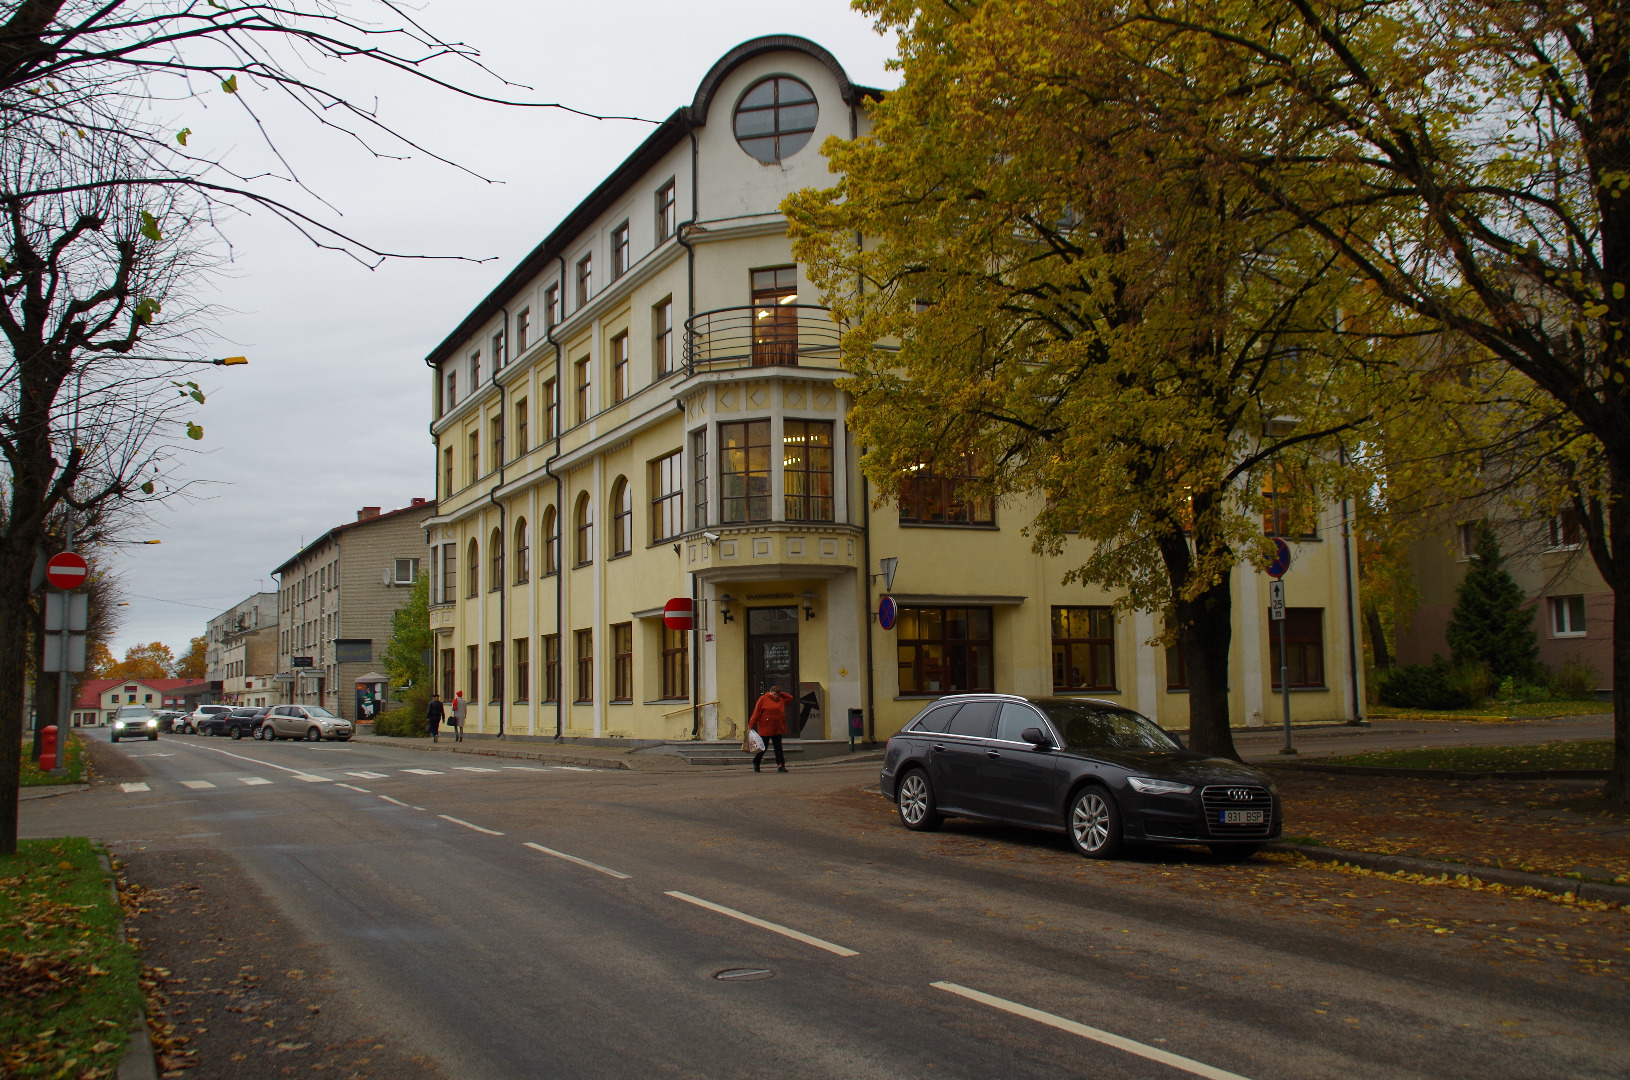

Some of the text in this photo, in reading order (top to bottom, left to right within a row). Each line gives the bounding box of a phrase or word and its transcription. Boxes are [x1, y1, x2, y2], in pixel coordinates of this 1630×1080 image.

[1273, 600, 1283, 609] 25
[1227, 812, 1241, 821] 931
[1246, 811, 1262, 821] BSP
